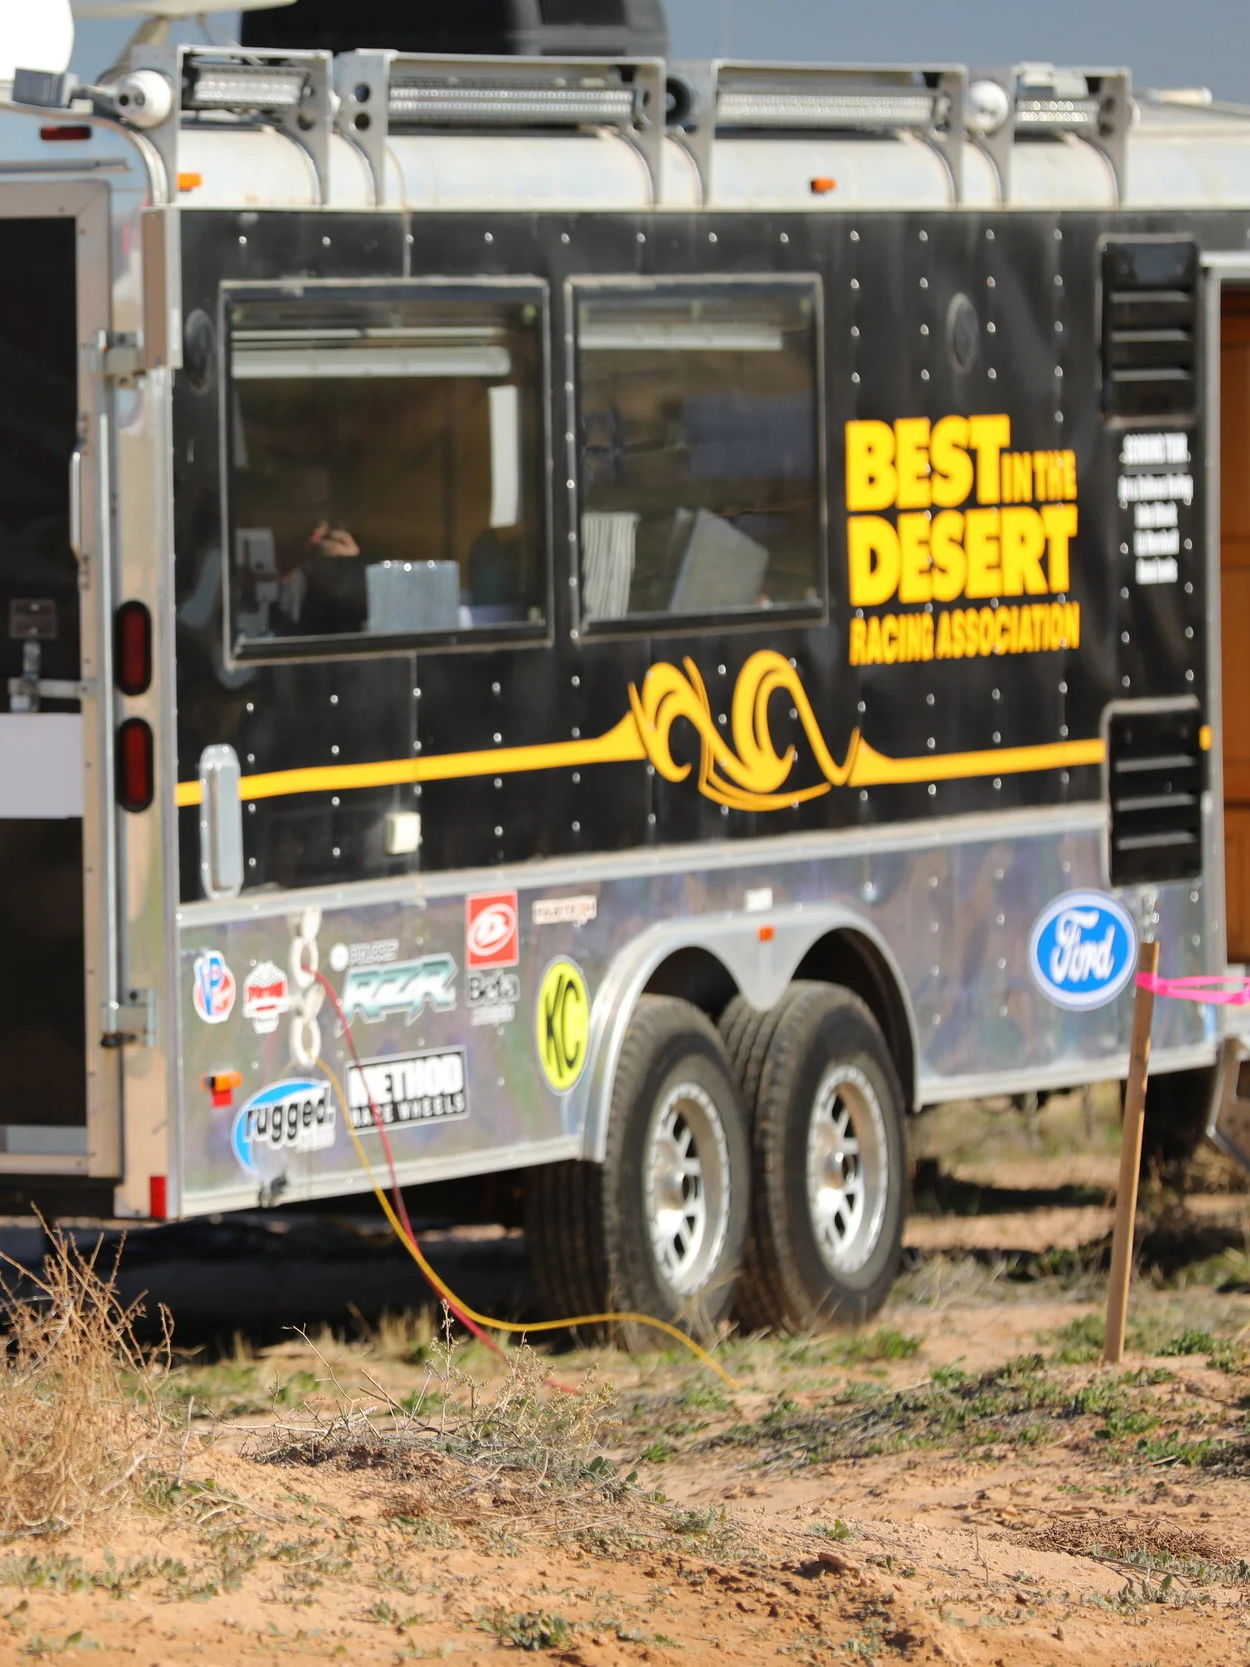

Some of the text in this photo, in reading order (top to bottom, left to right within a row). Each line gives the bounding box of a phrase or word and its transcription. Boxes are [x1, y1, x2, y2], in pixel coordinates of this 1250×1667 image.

[845, 414, 1011, 512] BEST
[1000, 452, 1033, 504] IN
[1033, 449, 1078, 502] THE
[847, 503, 1079, 606] DESERT
[849, 601, 1081, 667] RACING ASSOCIATION
[1051, 909, 1115, 984] Ford
[546, 973, 579, 1079] KC
[349, 1053, 464, 1108] METHOD
[397, 1092, 466, 1121] WHEELS
